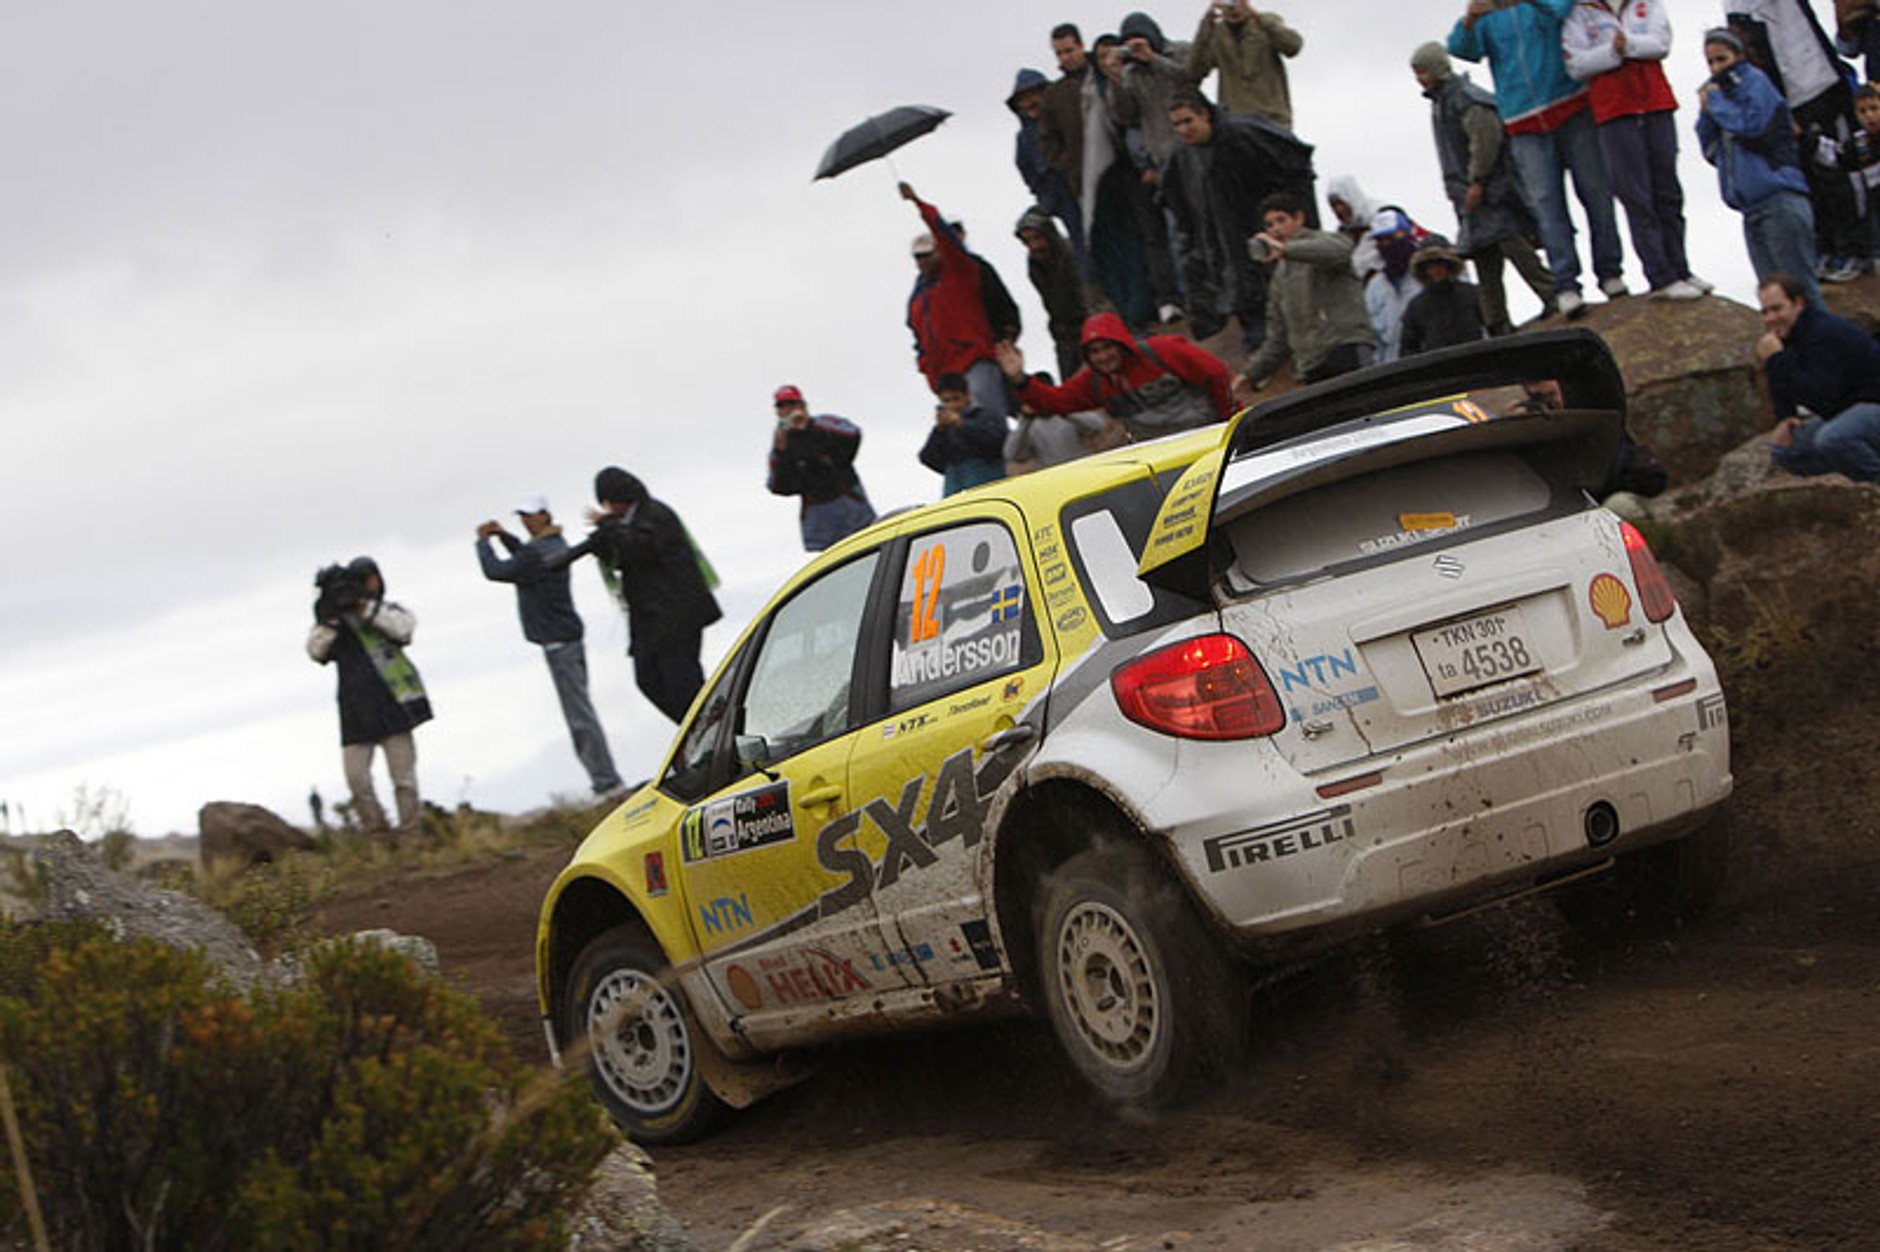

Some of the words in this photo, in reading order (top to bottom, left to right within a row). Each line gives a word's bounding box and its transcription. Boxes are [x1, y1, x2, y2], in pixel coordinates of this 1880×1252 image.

[912, 542, 946, 645] 12
[1438, 661, 1458, 680] ta
[1463, 636, 1531, 680] 4538
[1440, 624, 1476, 647] TKN
[890, 629, 1021, 690] Andersson
[1280, 647, 1357, 693] NTN
[737, 810, 792, 843] Argentina
[816, 746, 994, 917] SX4
[1203, 803, 1356, 873] PIRELLI
[698, 892, 753, 938] NTN
[764, 957, 871, 1005] HELIX
